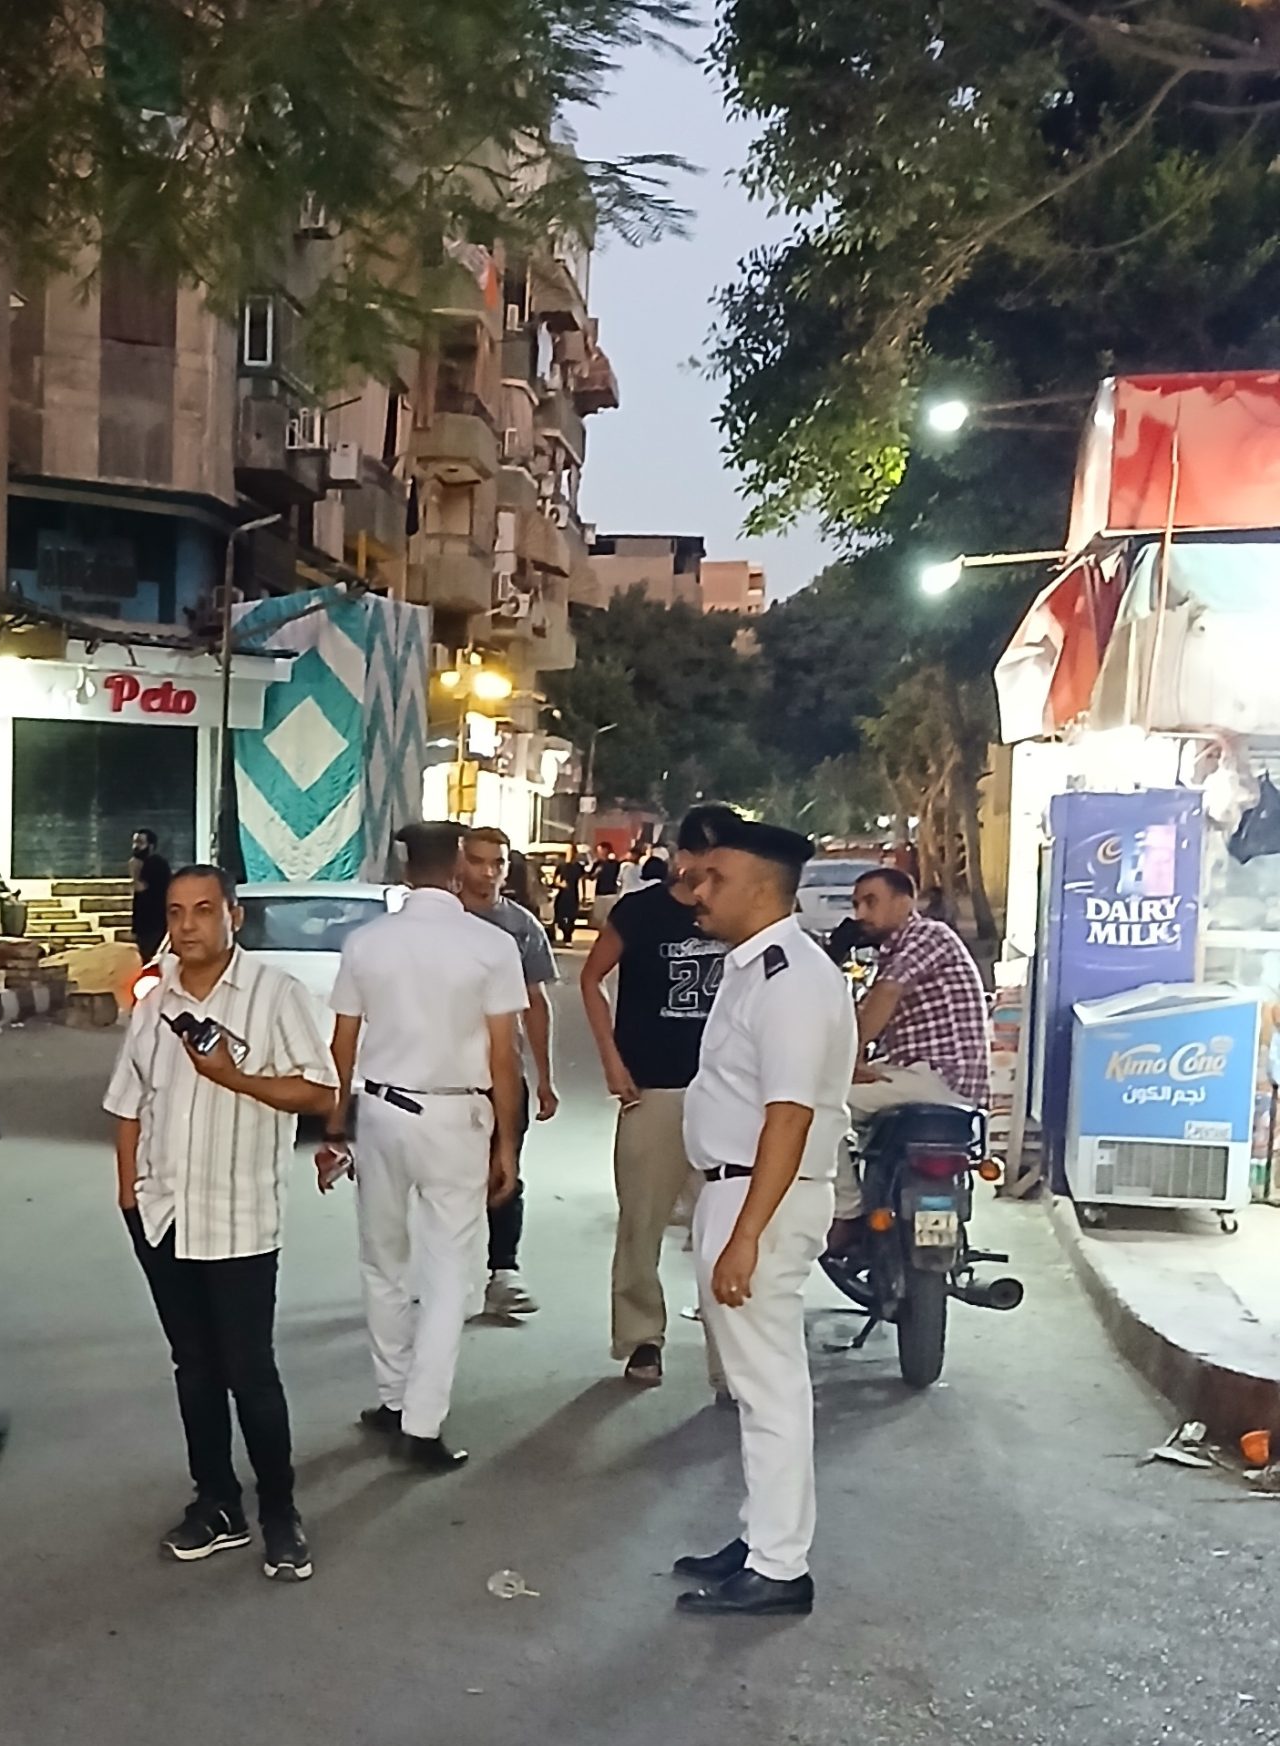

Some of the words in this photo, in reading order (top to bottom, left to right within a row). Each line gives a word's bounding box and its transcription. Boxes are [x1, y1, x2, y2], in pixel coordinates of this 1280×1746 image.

[1086, 896, 1181, 922] DAIRY
[1086, 921, 1181, 946] MILK
[1105, 1043, 1167, 1082] Kimo
